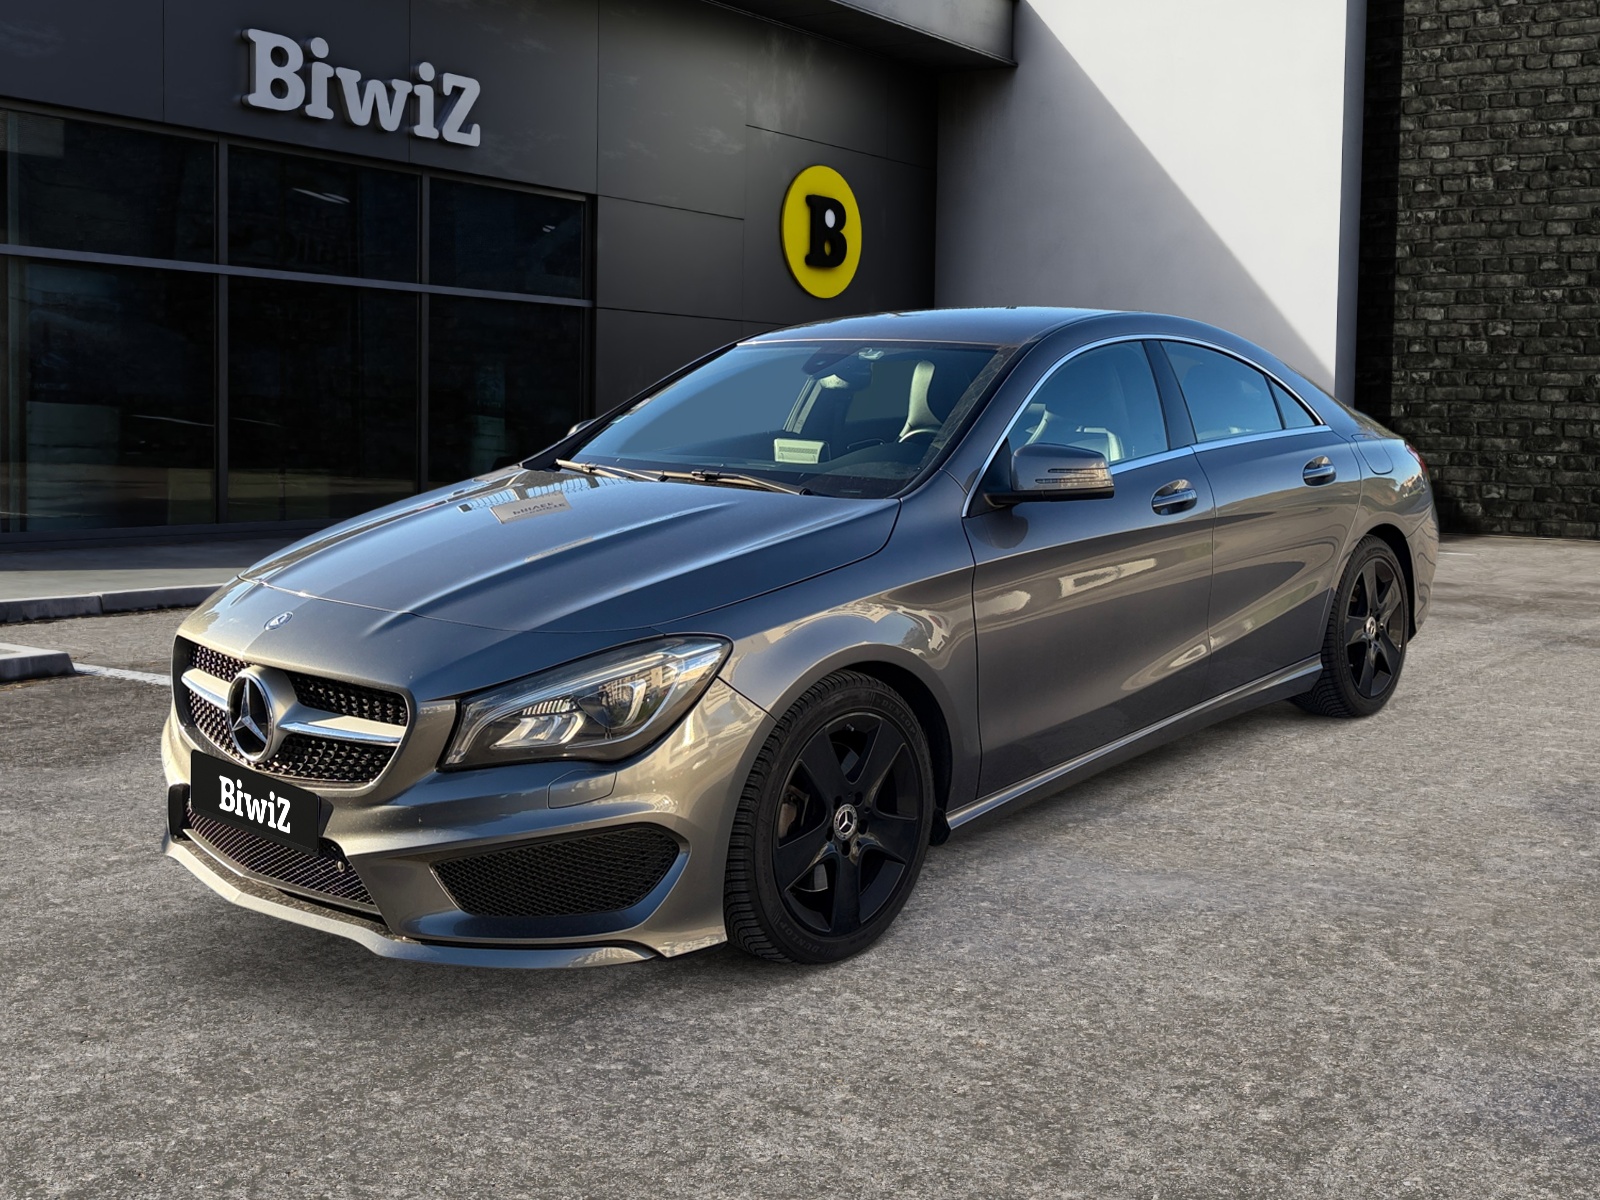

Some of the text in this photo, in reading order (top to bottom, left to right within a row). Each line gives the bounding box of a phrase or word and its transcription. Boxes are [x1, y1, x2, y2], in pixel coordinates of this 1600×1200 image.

[244, 28, 481, 147] BiwiZ
[805, 194, 847, 268] B
[219, 775, 290, 833] BiwiZ
